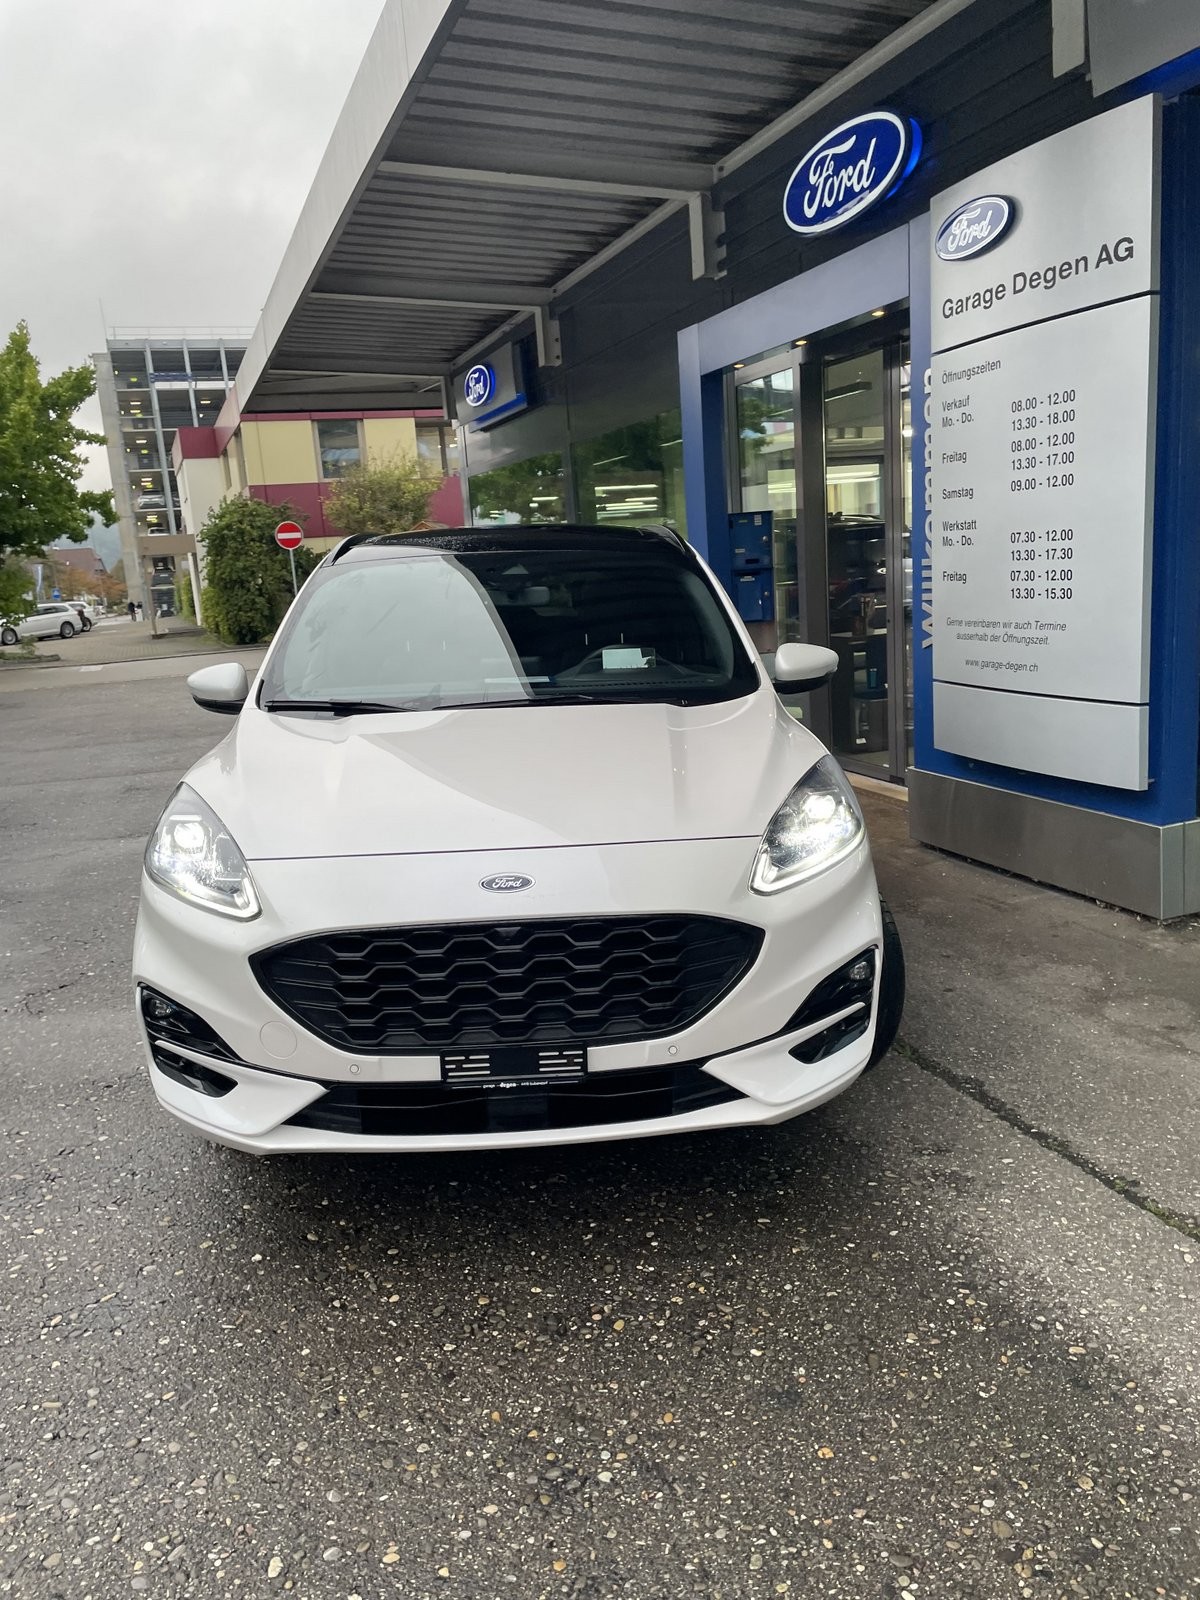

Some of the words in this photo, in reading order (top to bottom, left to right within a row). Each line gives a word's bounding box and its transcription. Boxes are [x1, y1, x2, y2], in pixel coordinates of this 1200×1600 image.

[803, 134, 876, 218] Ford
[947, 207, 993, 251] Ford
[942, 283, 1006, 319] Garage
[1012, 255, 1089, 296] Degen
[1095, 236, 1135, 270] AG
[941, 359, 1001, 385] Öffnungszeiten
[941, 395, 971, 412] Verkauf
[941, 416, 955, 428] Mo.
[961, 412, 974, 424] Do.
[1011, 397, 1037, 413] 08.00
[1047, 389, 1076, 406] 12.00
[1011, 416, 1037, 431] 13.30
[1046, 409, 1076, 425] 18.00
[942, 451, 967, 464] Freitag
[1011, 438, 1037, 452] 08.00
[1046, 431, 1075, 446] 12.00
[1011, 456, 1036, 471] 13.30
[1046, 451, 1075, 466] 17.00
[942, 487, 974, 500] Samstag
[1010, 478, 1036, 492] 09.00
[1046, 473, 1074, 488] 12.00
[942, 520, 977, 532] Werkstatt
[942, 536, 955, 547] Mo.
[961, 535, 974, 546] Do.
[1010, 531, 1036, 544] 07.30
[1045, 529, 1074, 542] 12.00
[1010, 549, 1036, 561] 13.30
[1045, 547, 1073, 560] 17.30
[942, 571, 967, 584] Freitag
[1010, 570, 1035, 581] 07.30
[1045, 569, 1073, 581] 12.00
[1010, 588, 1035, 599] 13.30
[1044, 588, 1073, 600] 15.30
[1002, 620, 1012, 629] wir
[1014, 621, 1032, 630] auch
[1034, 620, 1067, 632] Termine
[956, 632, 989, 642] ausserhalb
[990, 633, 1002, 642] der
[1002, 631, 1050, 646] Öffnungszeit.
[965, 658, 1039, 673] www.garage-degen.ch
